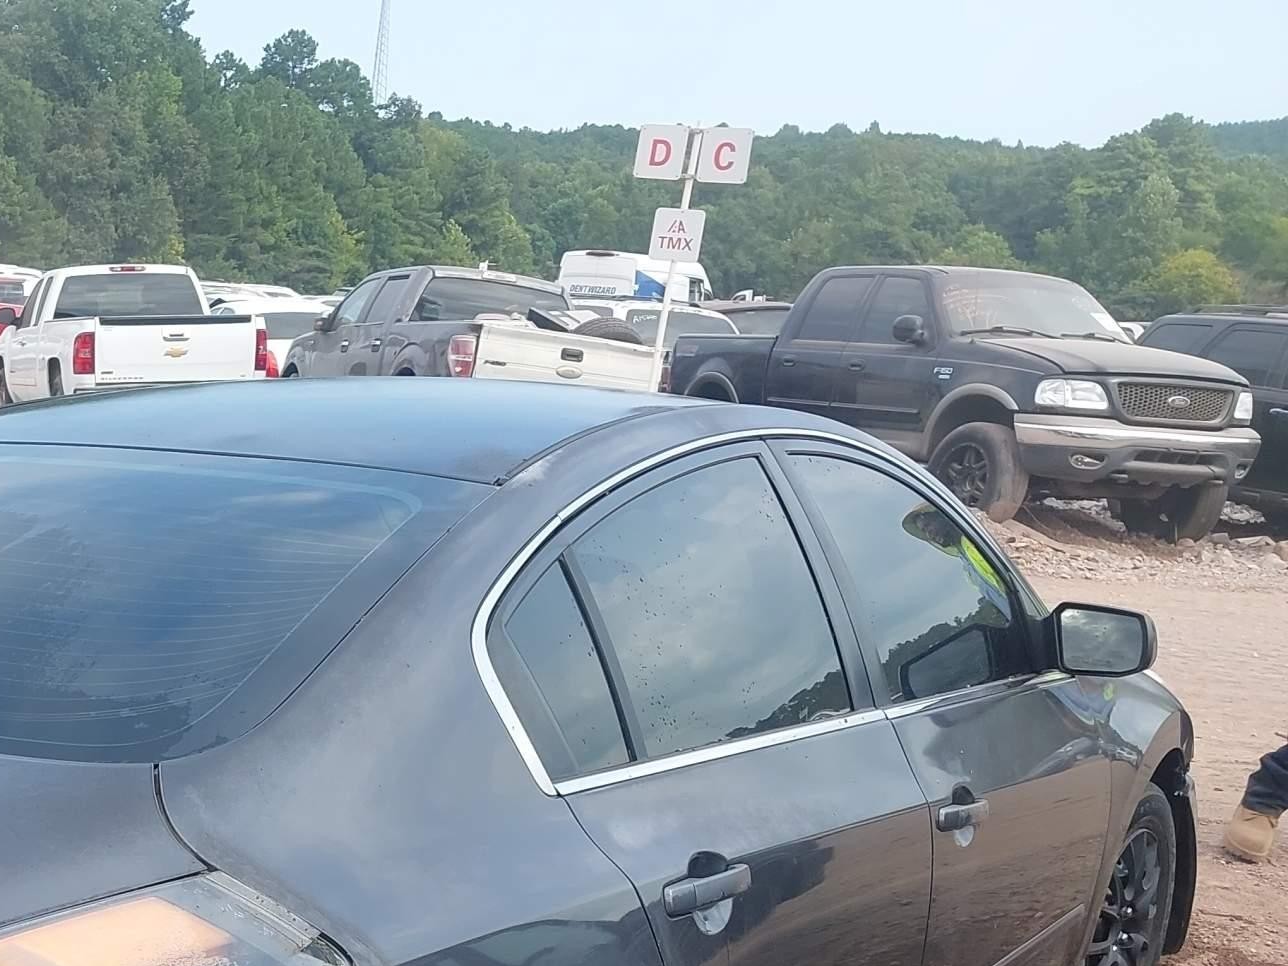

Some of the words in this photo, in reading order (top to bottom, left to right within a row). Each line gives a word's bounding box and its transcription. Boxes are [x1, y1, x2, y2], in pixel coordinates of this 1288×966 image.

[648, 139, 672, 167] D
[713, 142, 736, 171] C
[658, 236, 694, 251] TMX
